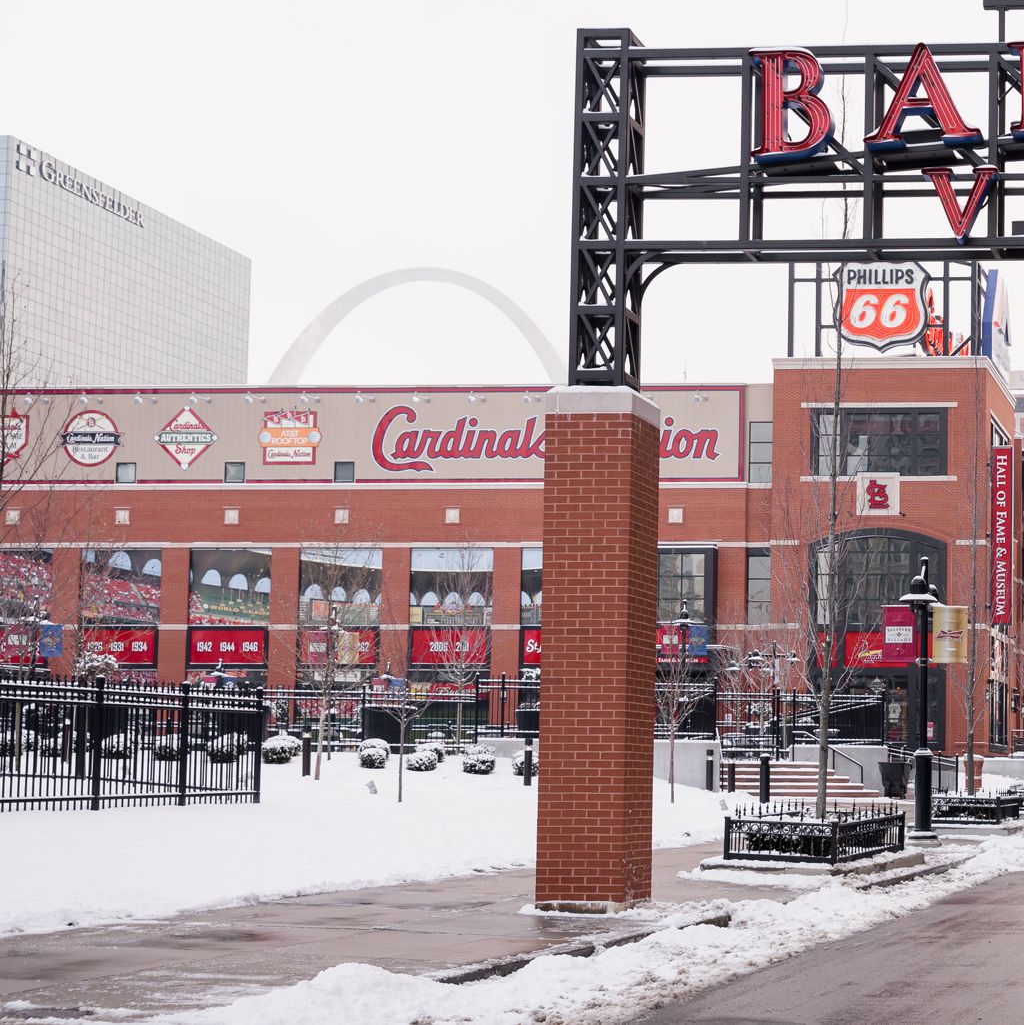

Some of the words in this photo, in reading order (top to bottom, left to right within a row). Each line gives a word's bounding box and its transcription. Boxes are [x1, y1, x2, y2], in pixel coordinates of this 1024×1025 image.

[846, 268, 914, 285] PHILLIPS
[850, 293, 910, 329] 66
[169, 420, 204, 432] Cardinals
[160, 433, 212, 442] AUTHENTICS
[660, 415, 720, 461] ion
[174, 443, 196, 456] Shop
[996, 455, 1008, 488] HALL
[996, 490, 1006, 508] OF
[996, 511, 1008, 544] FAME
[995, 547, 1007, 559] &
[995, 560, 1007, 616] MUSEUM
[131, 641, 148, 652] 1934
[197, 641, 213, 652] 1942
[220, 641, 235, 652] 1944
[242, 641, 258, 652] 1946
